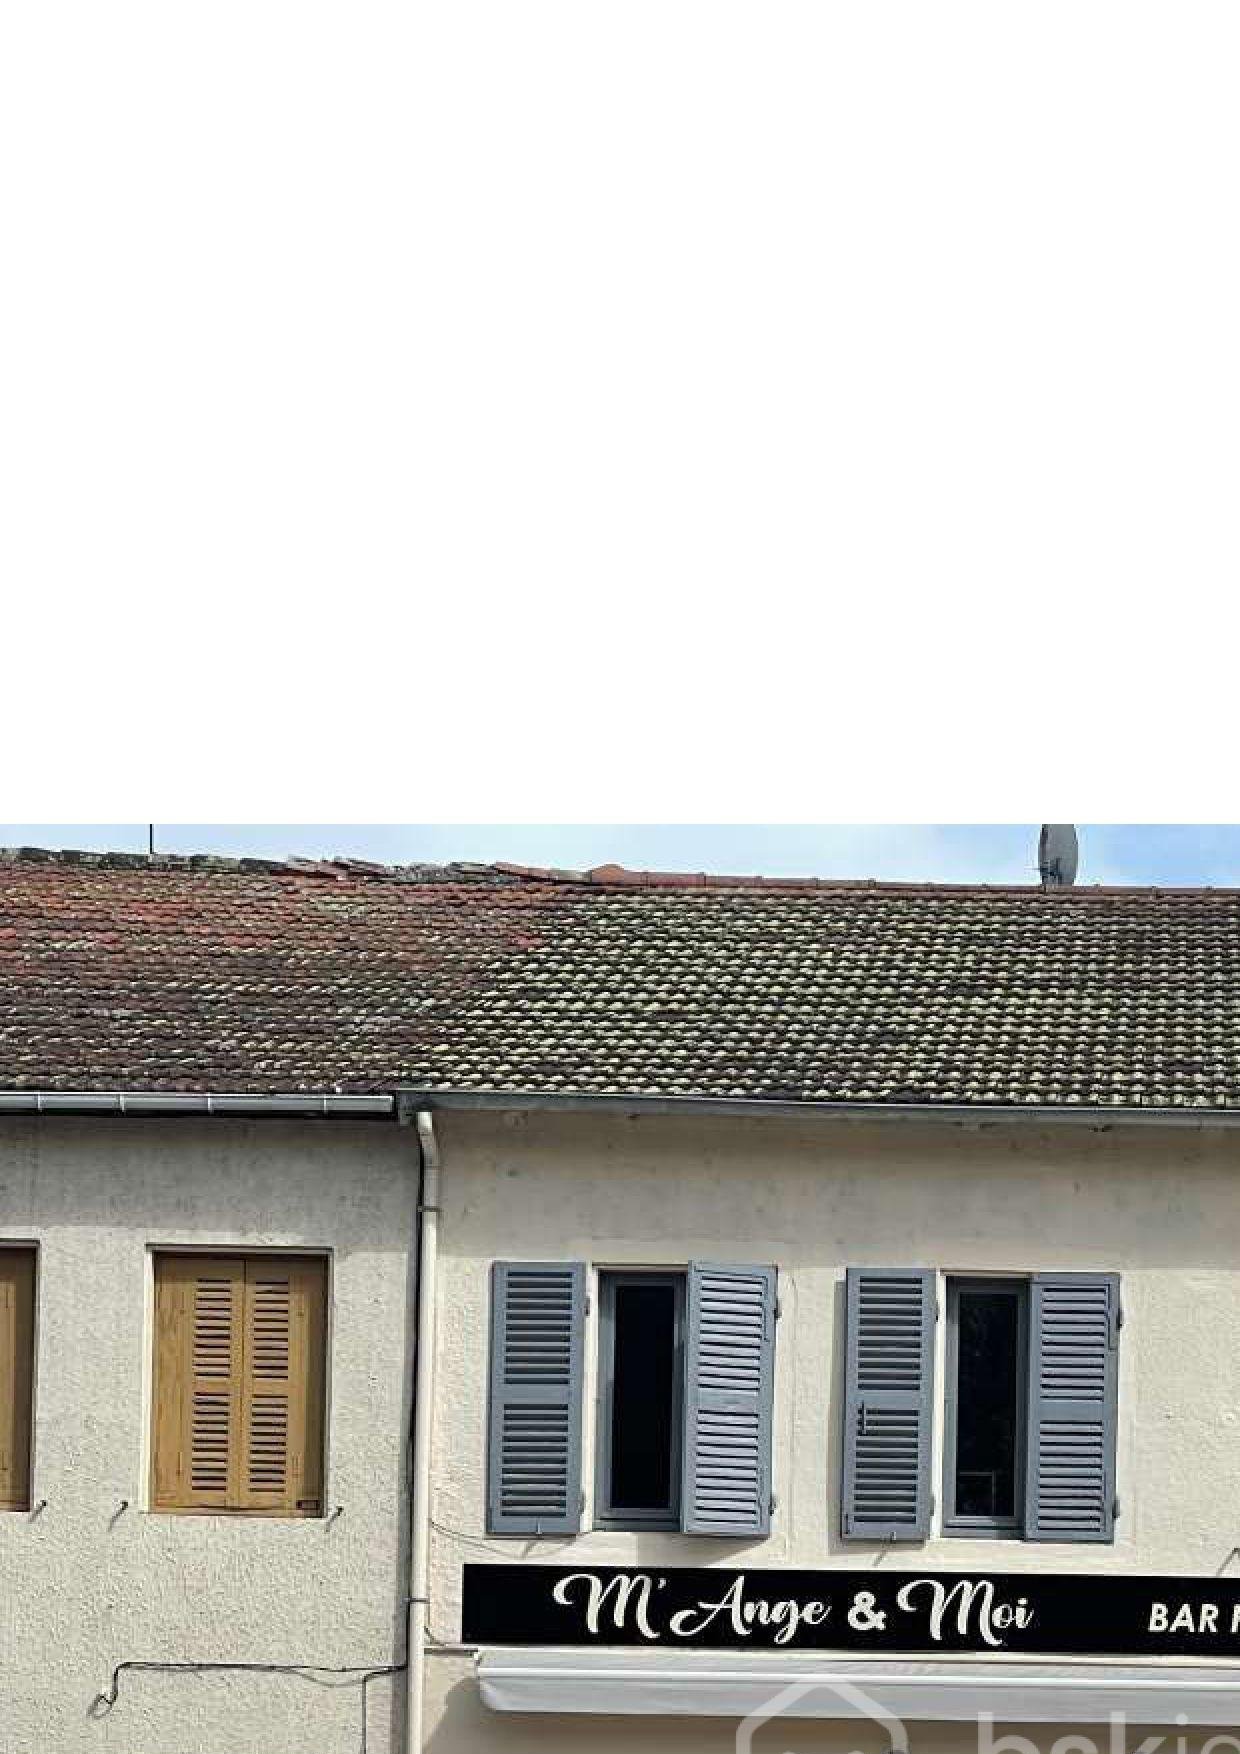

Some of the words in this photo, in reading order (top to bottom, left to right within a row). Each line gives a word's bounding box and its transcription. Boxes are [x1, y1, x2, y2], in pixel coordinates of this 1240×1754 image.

[846, 1590, 887, 1632] &
[896, 1578, 1034, 1646] Moi
[1147, 1602, 1219, 1634] BAR
